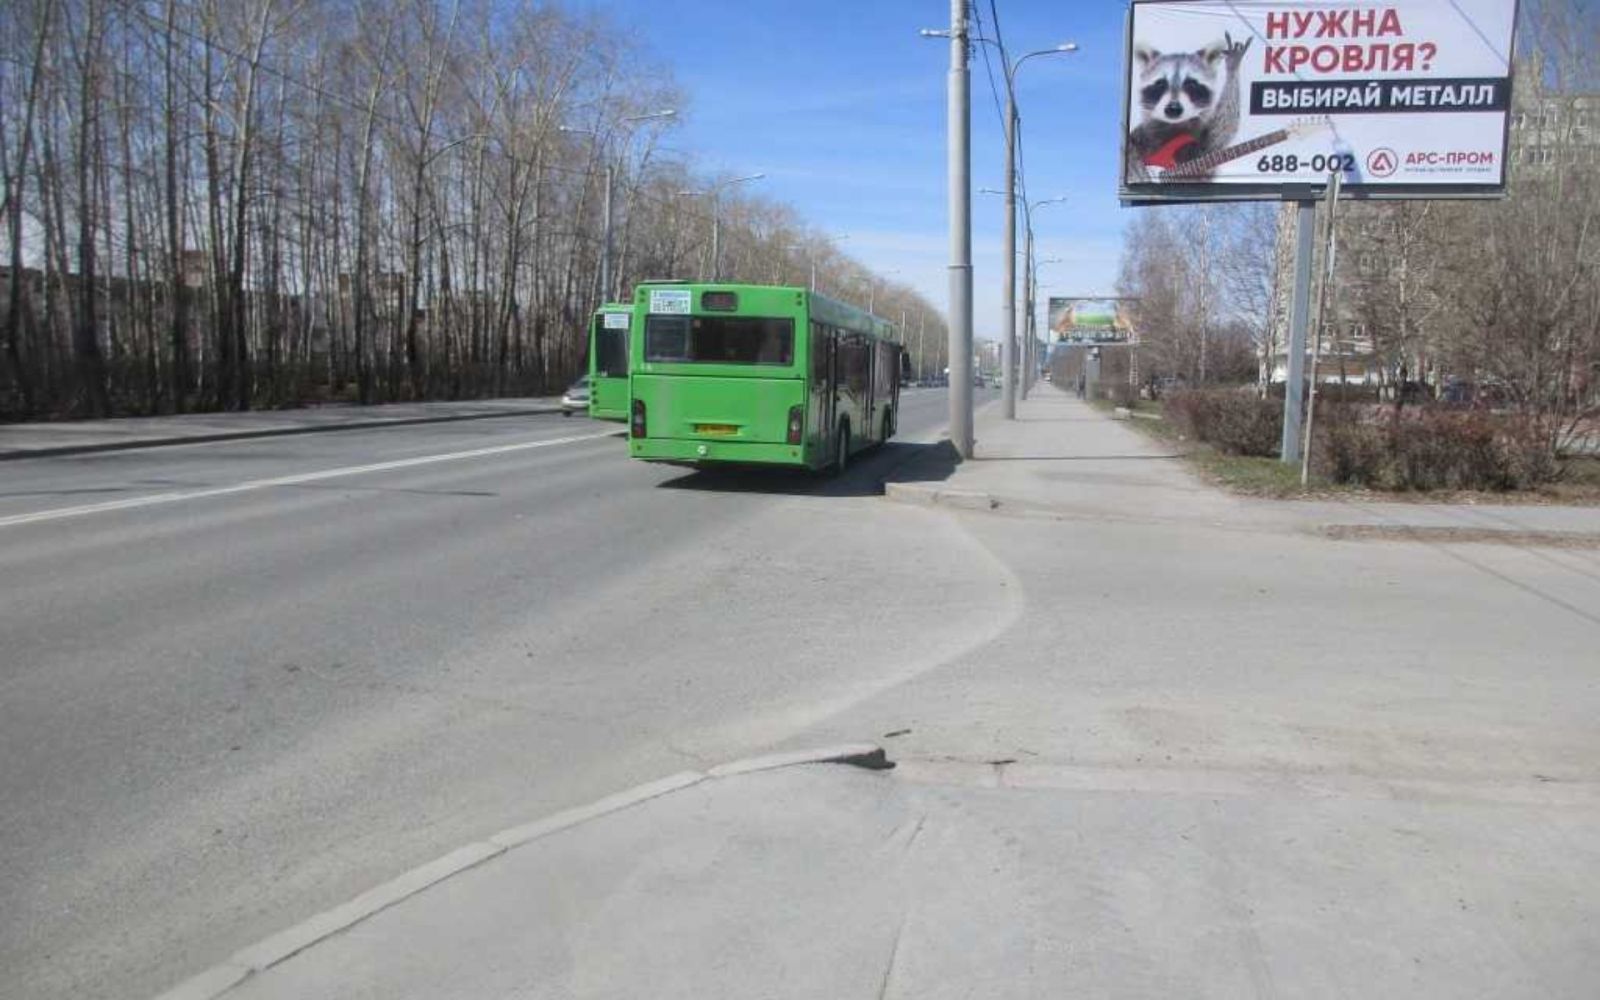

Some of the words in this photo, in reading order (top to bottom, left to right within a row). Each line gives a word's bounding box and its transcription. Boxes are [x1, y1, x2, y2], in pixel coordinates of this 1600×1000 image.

[1266, 8, 1403, 39] НУЖНА
[1263, 41, 1437, 74] КРОВЛЯ?
[1261, 82, 1381, 109] ВЫБИРАЙ
[1390, 84, 1495, 107] МЕТАЛЛ
[1257, 153, 1355, 172] 688-002
[1405, 151, 1494, 165] АРС-ПРОМ
